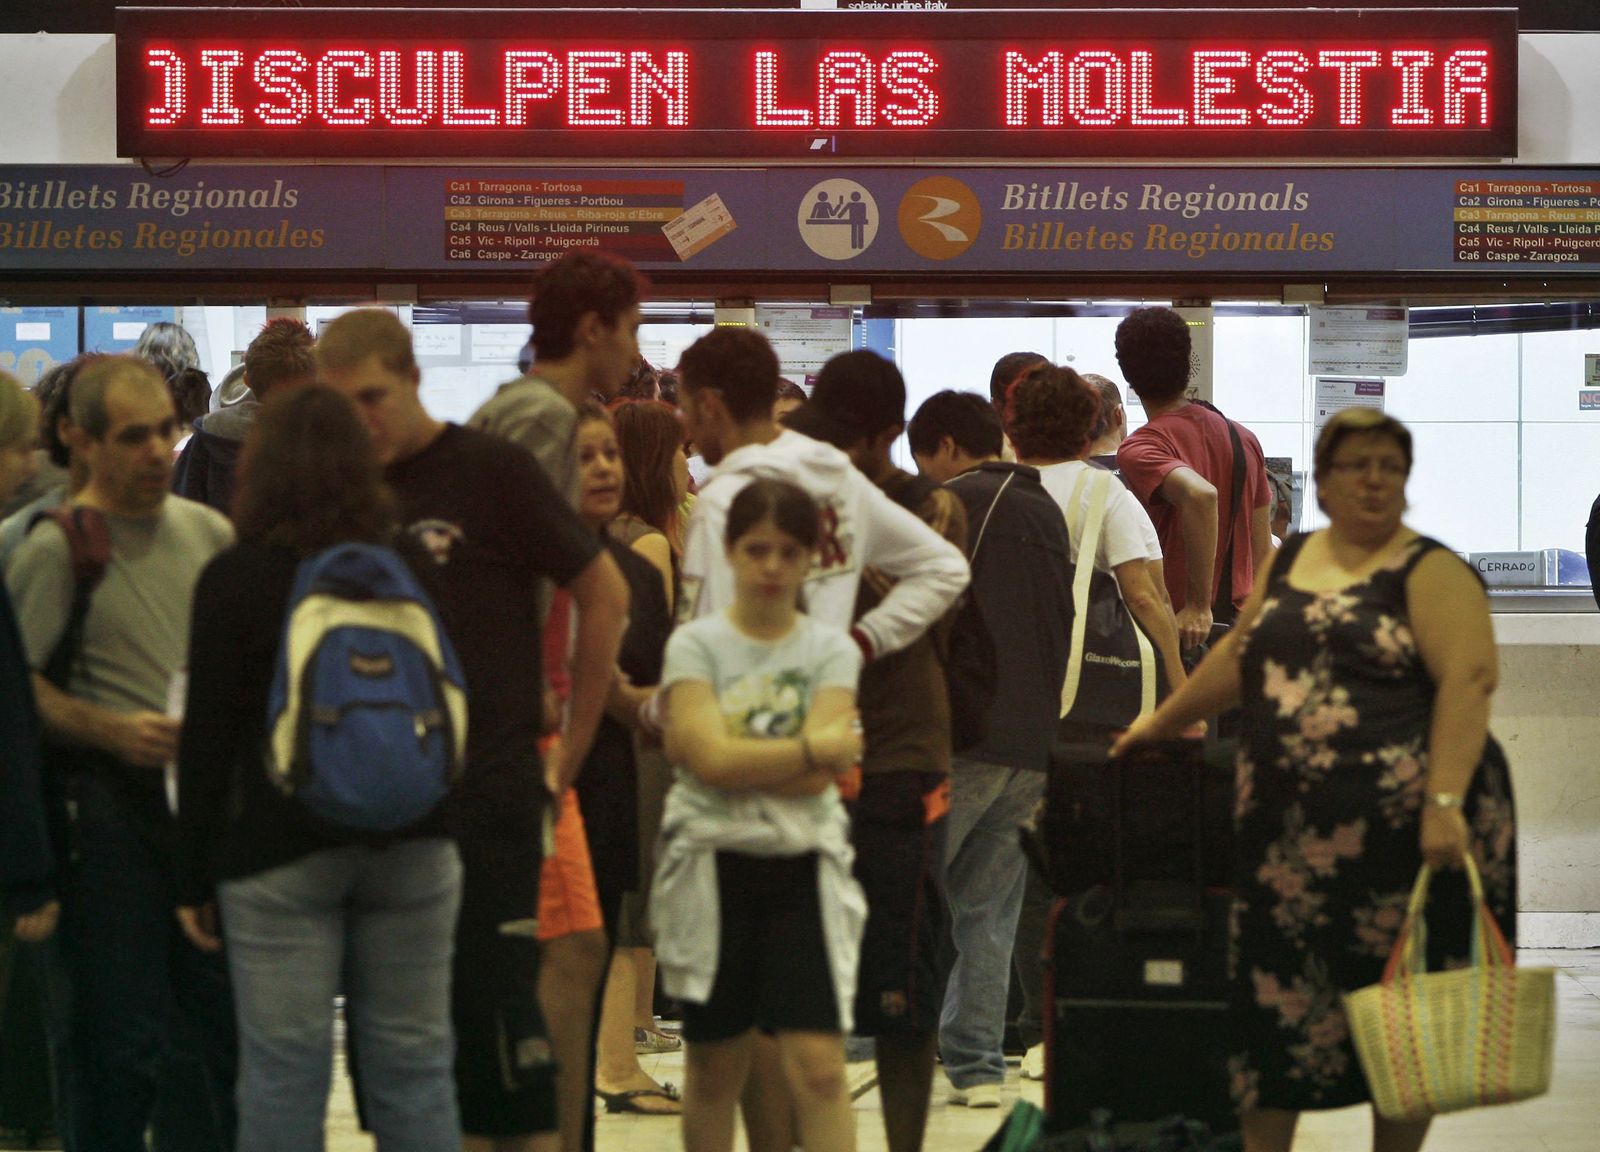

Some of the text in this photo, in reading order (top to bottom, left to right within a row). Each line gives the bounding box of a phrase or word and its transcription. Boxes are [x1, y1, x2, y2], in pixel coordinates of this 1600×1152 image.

[753, 51, 939, 126] LAS
[1005, 50, 1488, 126] MOLESTIA
[450, 182, 471, 191] Ca1
[478, 182, 532, 194] Tarragona
[542, 182, 583, 192] Tortosa
[1459, 183, 1480, 193] Ca1
[1487, 183, 1541, 195] Tarragona
[1551, 183, 1592, 193] Tortosa
[126, 180, 299, 216] Regionals
[450, 195, 472, 205] Ca2
[477, 195, 515, 205] Girona
[524, 196, 571, 208] Figueres
[580, 196, 624, 206] Portbou
[1001, 182, 1309, 219] Bitllets Regionals
[1459, 196, 1480, 206] Ca2
[1487, 196, 1523, 207] Girona
[1533, 197, 1580, 209] Figueres
[450, 209, 471, 218] Ca3
[476, 209, 530, 220] Tarragona
[540, 209, 568, 218] Reus
[576, 210, 626, 221] Riba-roja
[1459, 210, 1480, 220] Ca3
[1485, 210, 1539, 222] Tarragona
[1549, 210, 1577, 220] Reus
[450, 222, 471, 232] Ca4
[477, 222, 505, 232] Reus
[514, 223, 541, 233] Valls
[550, 223, 583, 233] Lleida
[585, 223, 630, 233] Pirineus
[1459, 223, 1480, 233] Ca4
[1486, 224, 1514, 234] Reus
[1523, 224, 1550, 234] Valls
[1559, 224, 1591, 234] Lleida
[133, 220, 325, 256] Regionales
[450, 236, 472, 245] Ca5
[477, 236, 495, 246] Vic
[504, 236, 536, 248] Ripoll
[1002, 222, 1335, 258] Billetes Regionales
[1459, 237, 1480, 247] Ca5
[1486, 237, 1504, 247] Vic
[1513, 237, 1545, 249] Ripoll
[450, 249, 471, 259] Ca6
[477, 249, 512, 261] Caspe
[1459, 250, 1480, 260] Ca6
[1486, 250, 1521, 262] Caspe
[1529, 251, 1580, 263] Zaragoza
[1478, 558, 1536, 573] CERRADO
